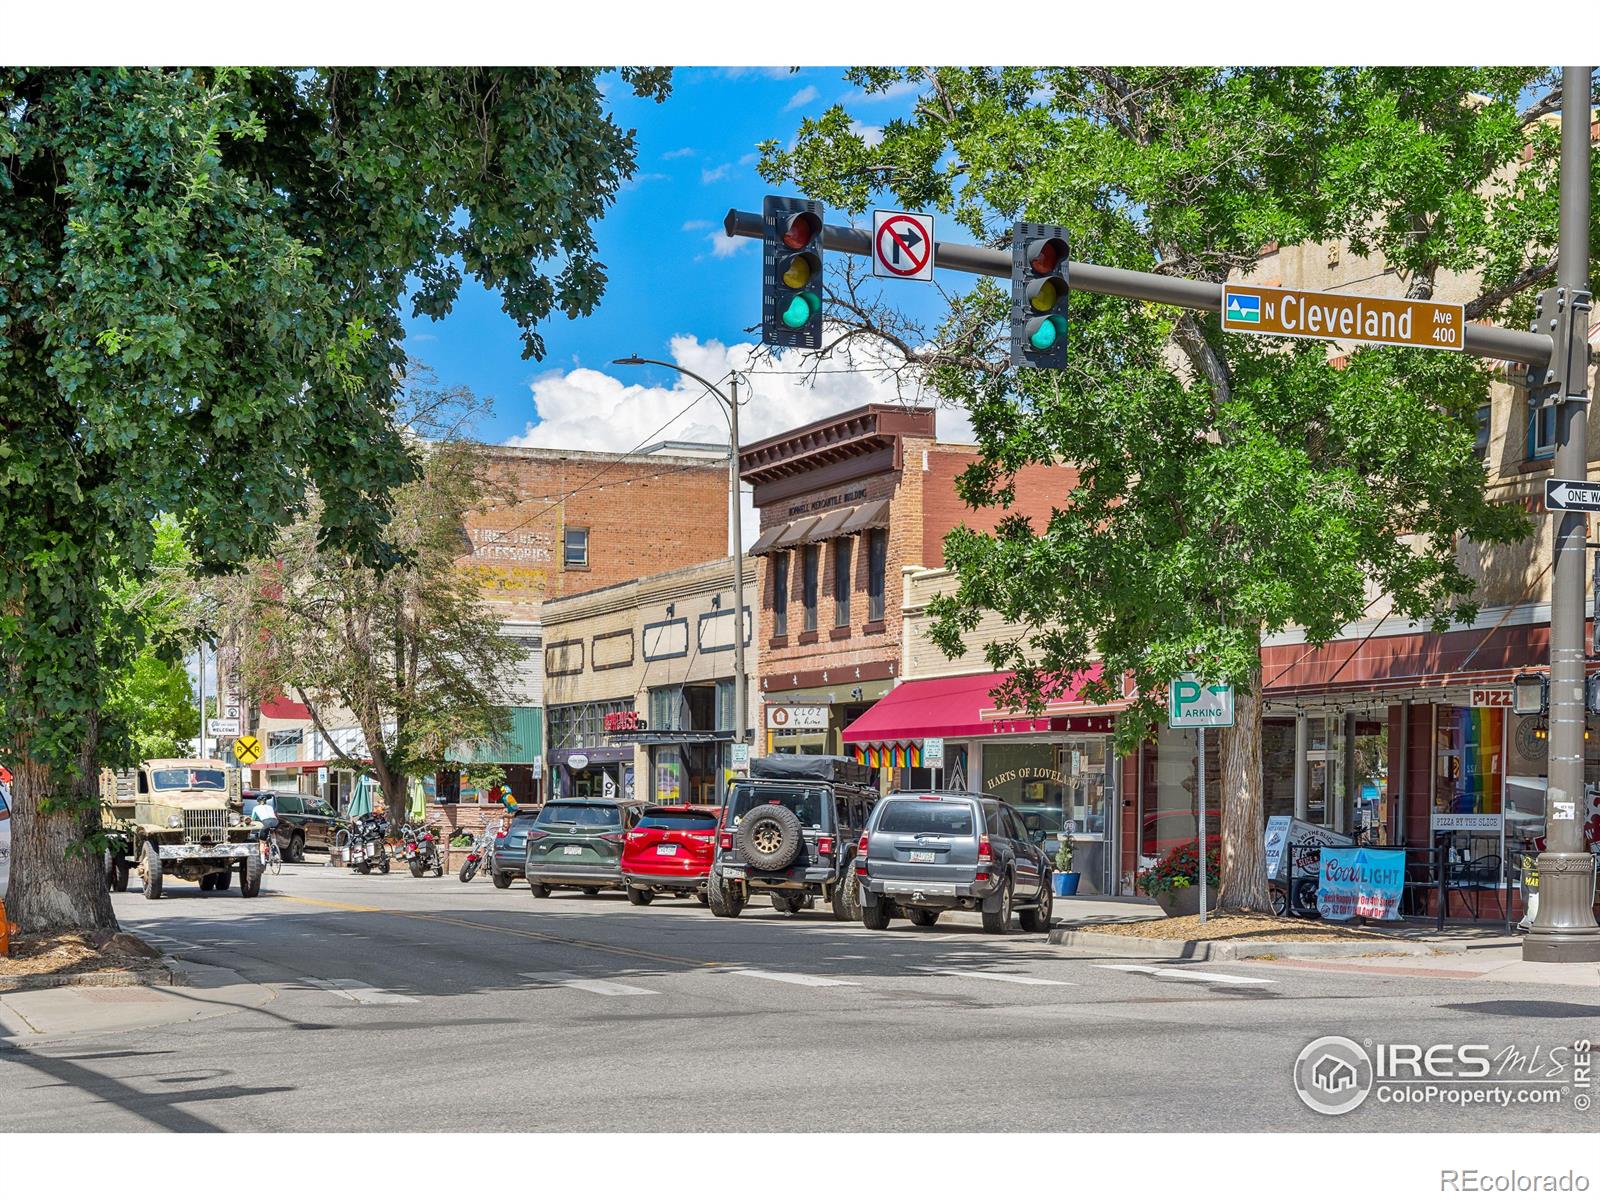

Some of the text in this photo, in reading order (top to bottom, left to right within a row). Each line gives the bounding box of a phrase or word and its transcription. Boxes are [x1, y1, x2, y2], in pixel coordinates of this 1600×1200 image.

[1265, 295, 1452, 339] N Cleveland Ave
[1432, 328, 1456, 342] 400
[1568, 490, 1588, 502] ONE
[987, 770, 1016, 789] HARTS
[1018, 767, 1031, 778] OF
[1034, 767, 1080, 790] LOVELAND
[1436, 818, 1498, 827] PIZZA BY THE SLICE
[1325, 858, 1399, 885] Coors LIGHT
